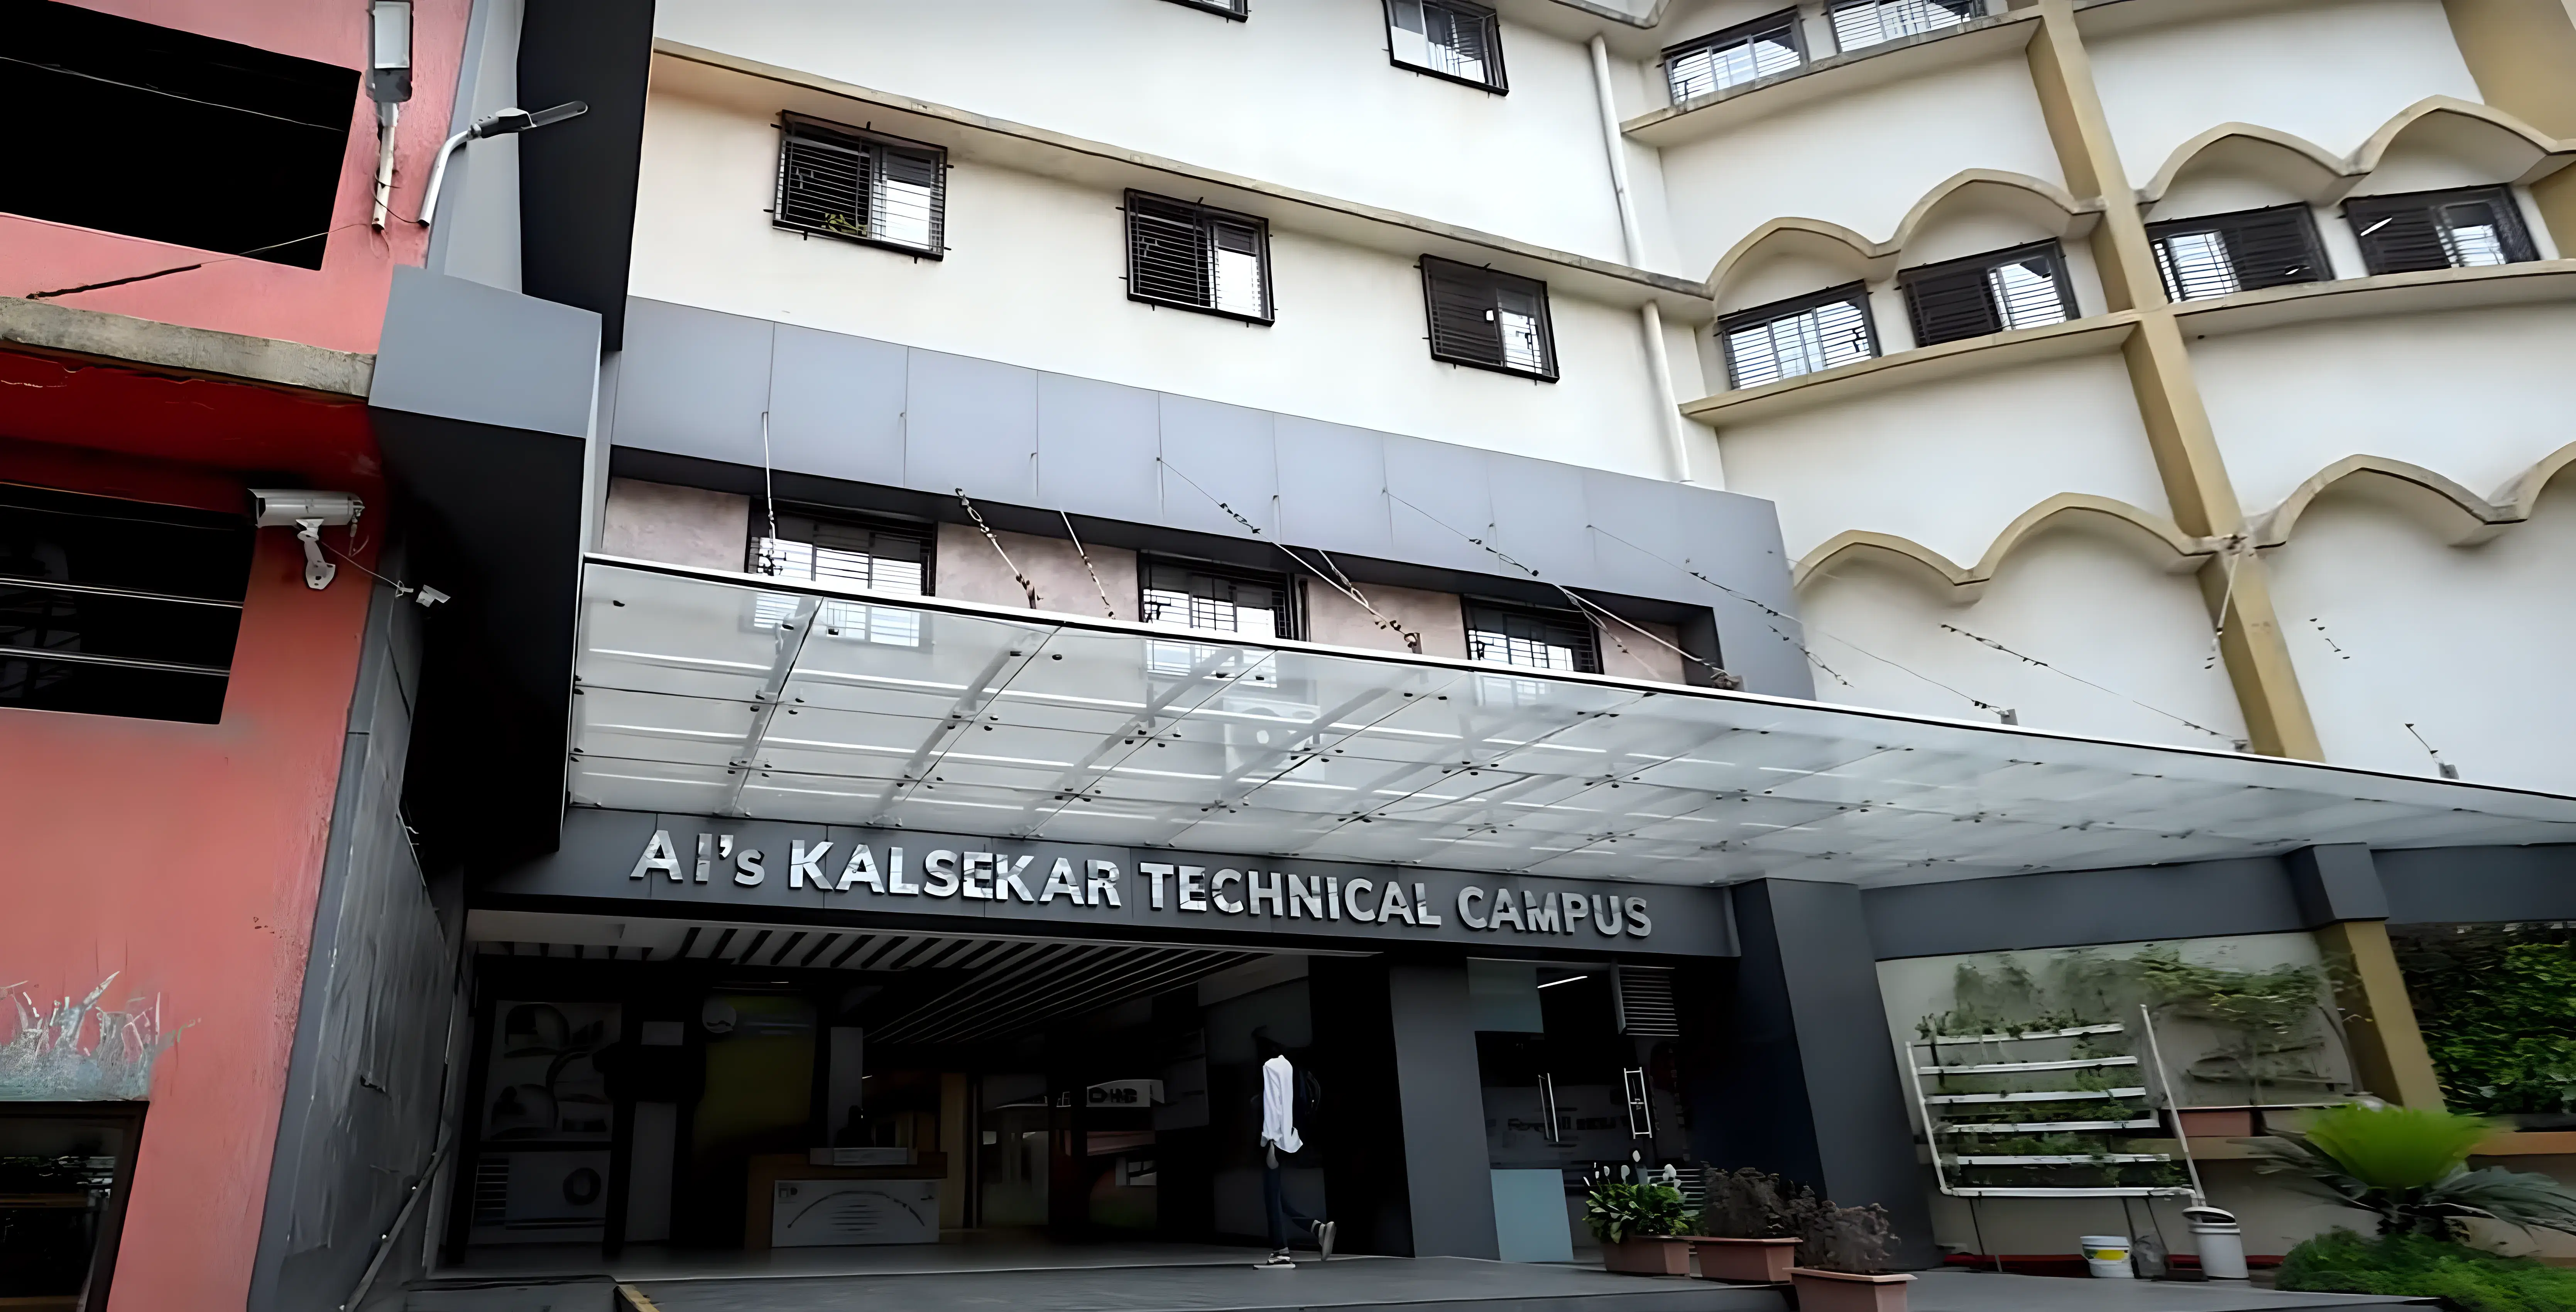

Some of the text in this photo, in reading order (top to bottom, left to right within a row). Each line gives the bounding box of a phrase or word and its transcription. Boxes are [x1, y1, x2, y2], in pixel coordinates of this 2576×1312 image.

[789, 839, 1121, 908] KALSEKAR
[1138, 861, 1442, 927] TECHNICAL
[1457, 884, 1652, 937] CAMPUS
